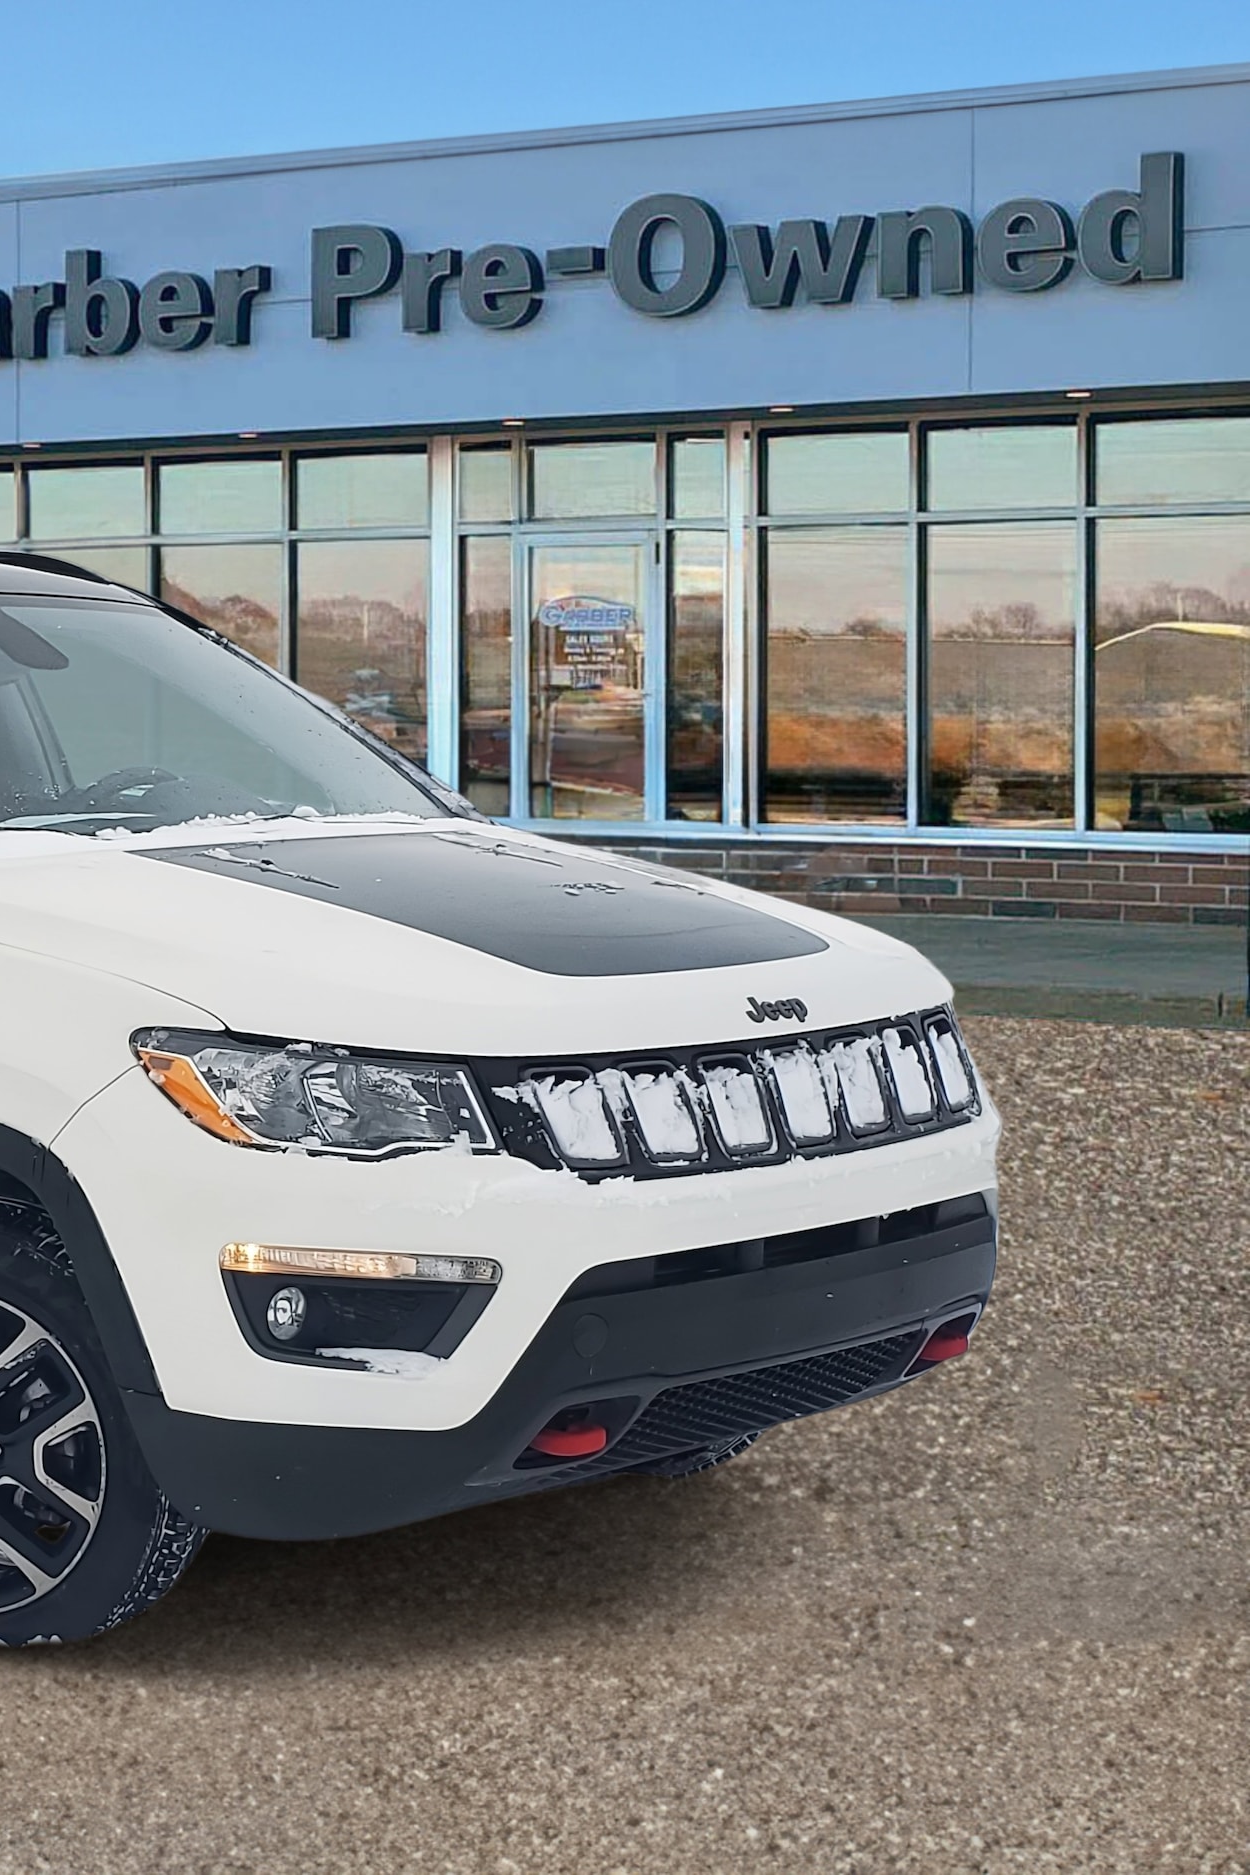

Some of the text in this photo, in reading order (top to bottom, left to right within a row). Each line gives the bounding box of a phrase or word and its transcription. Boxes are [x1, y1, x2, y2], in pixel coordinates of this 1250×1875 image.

[311, 151, 1185, 339] Pre-Owned
[542, 605, 633, 625] GARBER
[745, 996, 808, 1023] Jeep
